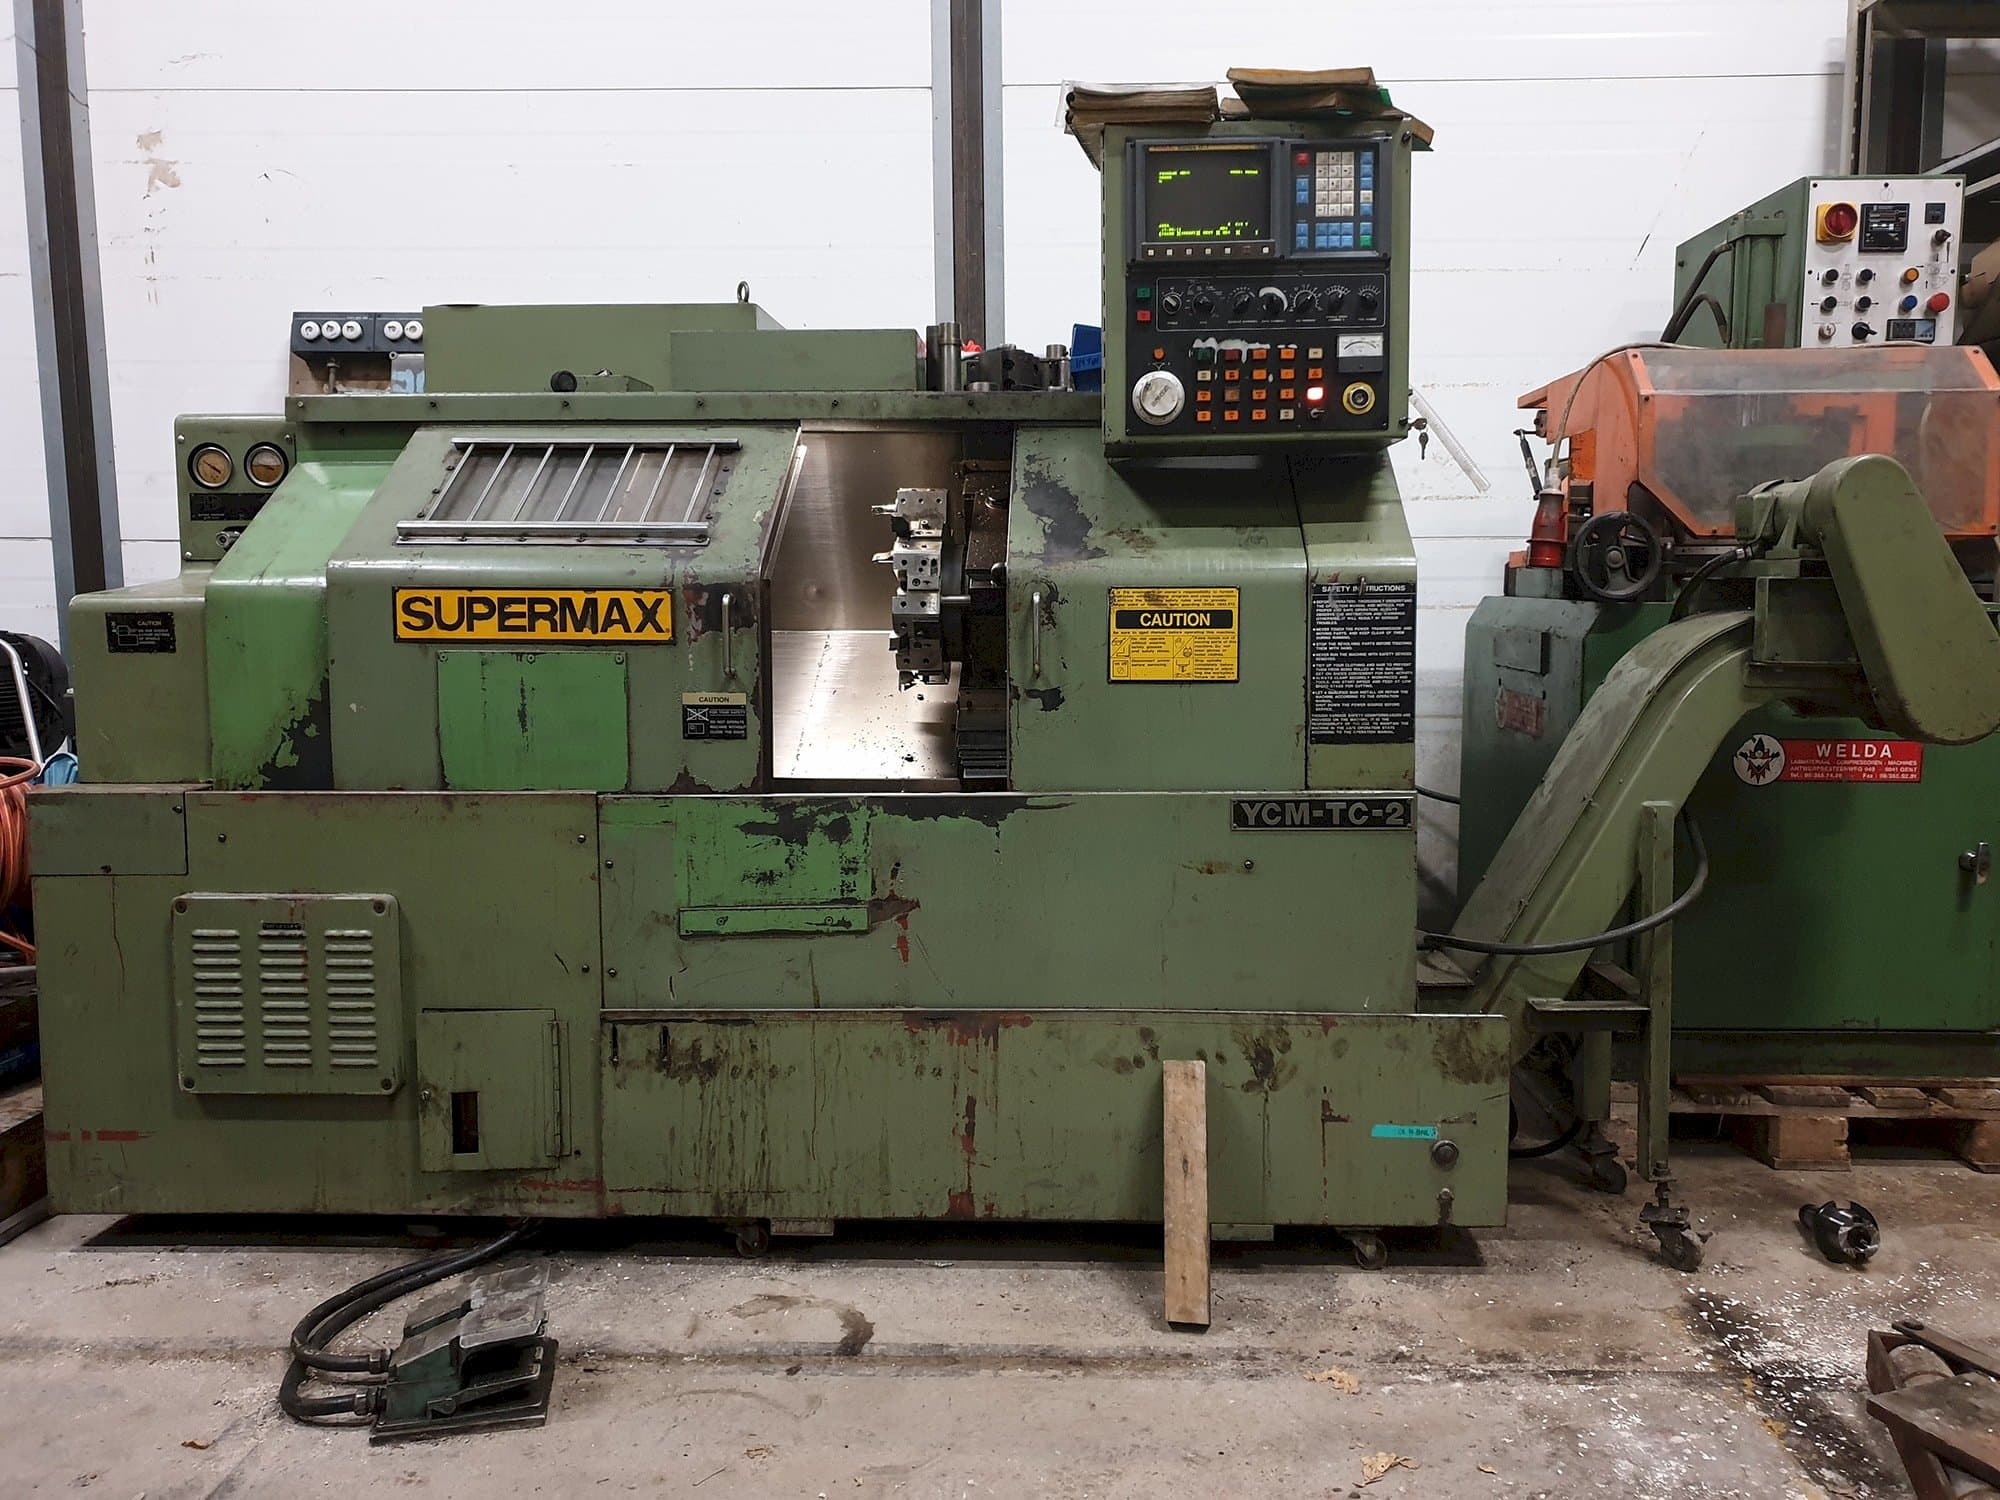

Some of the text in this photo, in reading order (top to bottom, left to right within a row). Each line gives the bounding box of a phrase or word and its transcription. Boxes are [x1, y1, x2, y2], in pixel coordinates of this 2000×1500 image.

[402, 596, 665, 634] SUPERMAX
[1140, 613, 1210, 626] CAUTION
[1816, 744, 1892, 758] WELDA
[1241, 802, 1404, 826] YCM-TC-2
